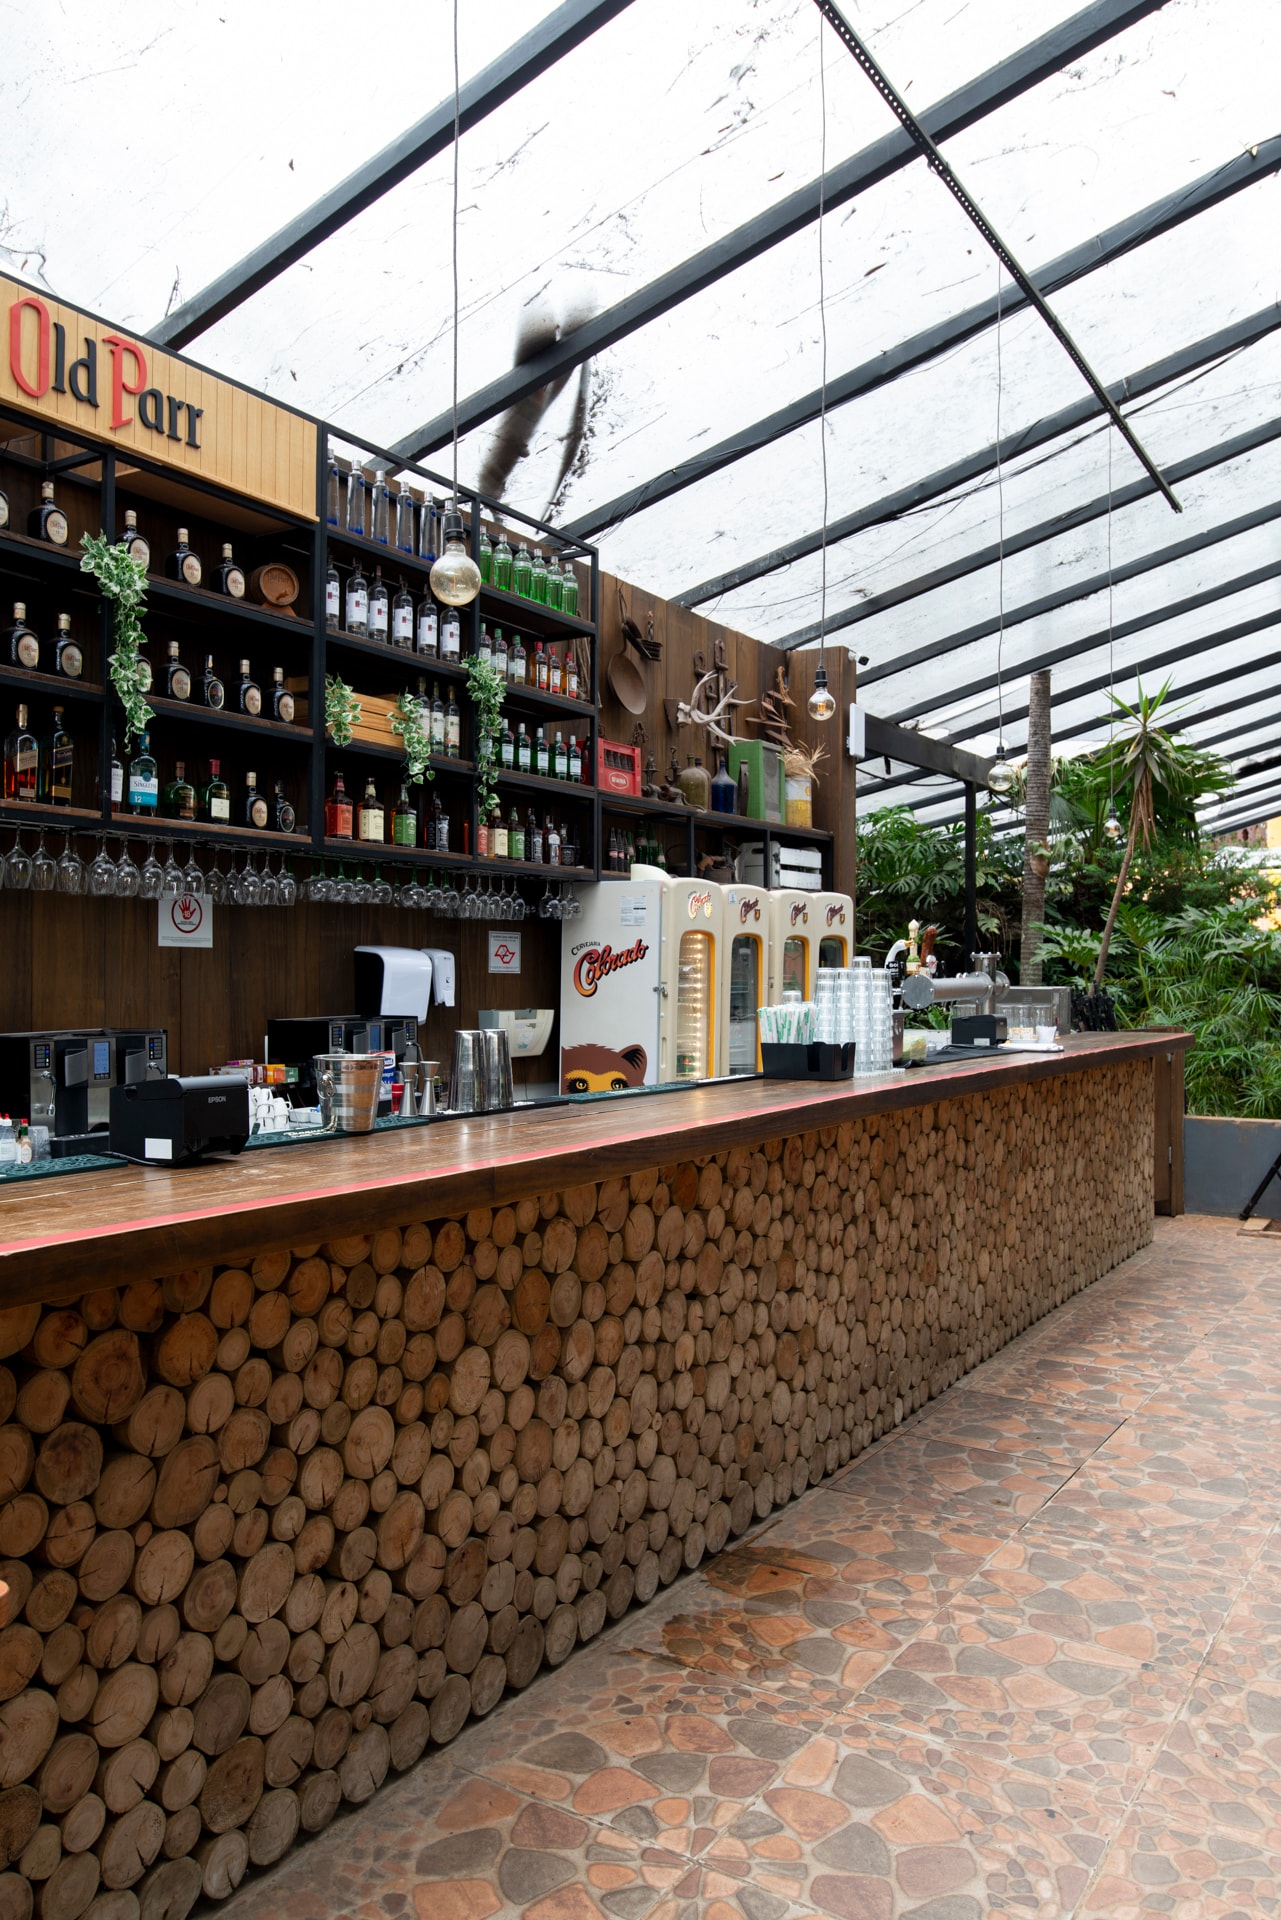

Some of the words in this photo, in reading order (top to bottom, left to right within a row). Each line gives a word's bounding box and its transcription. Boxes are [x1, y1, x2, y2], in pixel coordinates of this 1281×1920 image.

[10, 297, 99, 407] Old
[102, 335, 203, 449] Parr
[134, 795, 142, 803] 12
[571, 941, 601, 956] CERVEJARIA
[573, 938, 649, 998] Colorado
[208, 1096, 227, 1104] EPSON
